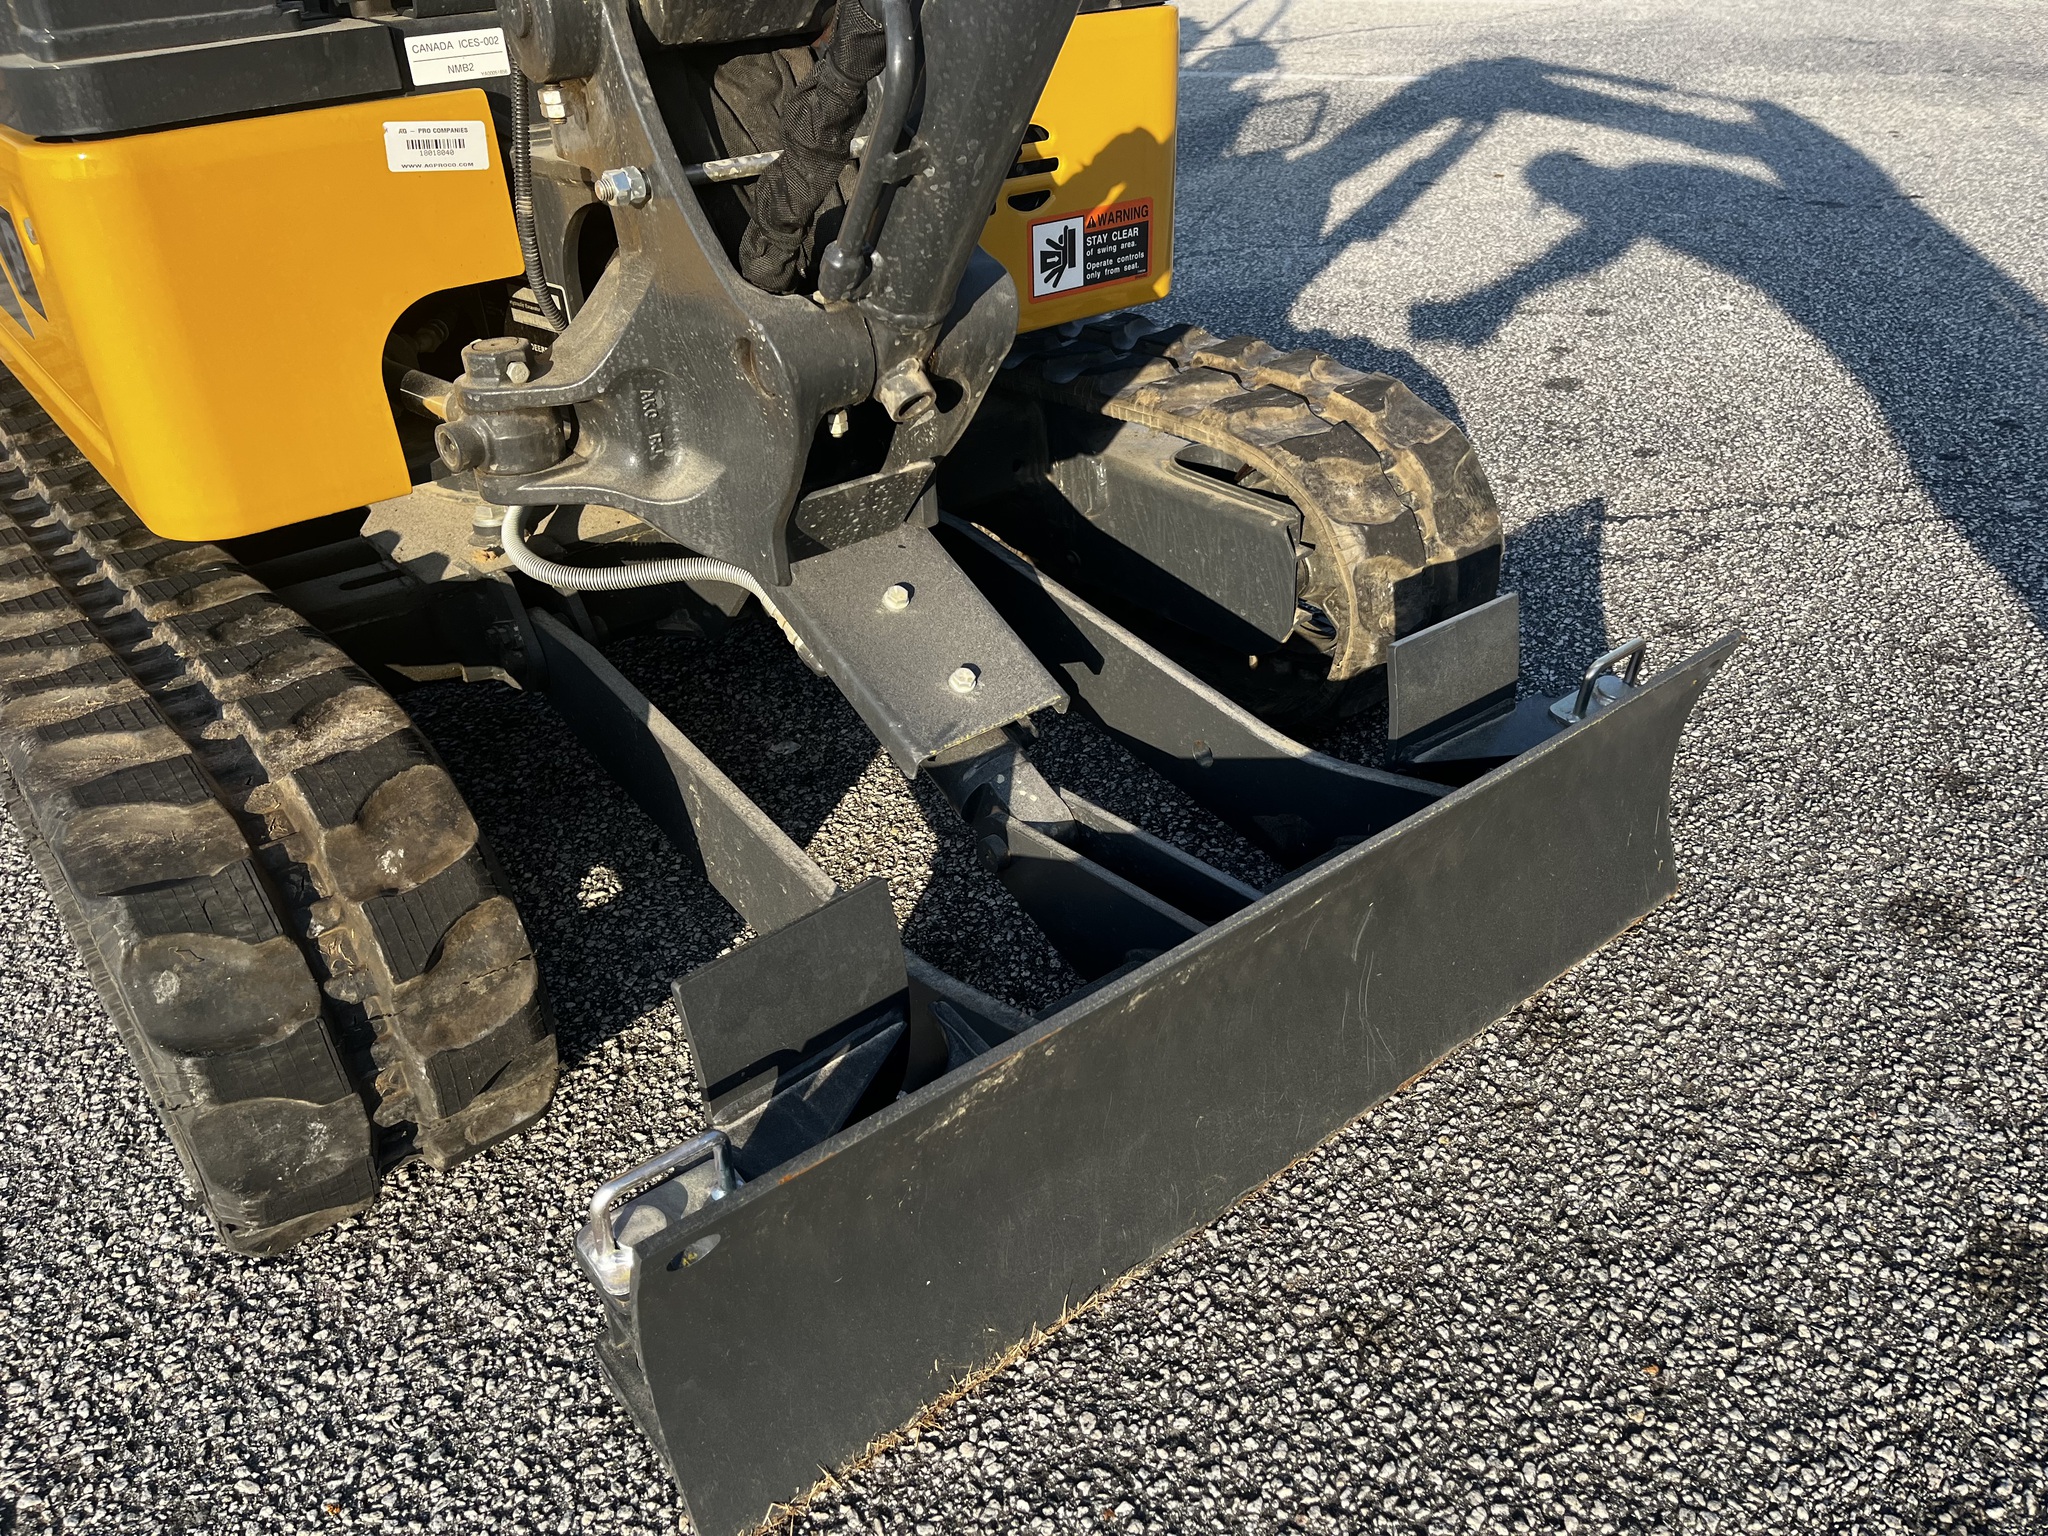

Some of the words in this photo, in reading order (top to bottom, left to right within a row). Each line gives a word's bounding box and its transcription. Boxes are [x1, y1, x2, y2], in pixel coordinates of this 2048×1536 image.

[411, 40, 454, 54] CANADA
[458, 35, 499, 49] ICES-002
[447, 62, 475, 74] NMB2
[1097, 204, 1149, 227] WARNING
[1086, 232, 1108, 247] STAY
[1111, 227, 1139, 241] CLEAR
[1086, 249, 1094, 257] of
[1097, 244, 1117, 255] swing
[1120, 240, 1137, 250] area.
[1086, 258, 1113, 271] Operate
[1117, 251, 1145, 264] controls
[1086, 268, 1101, 280] only
[1104, 266, 1121, 276] from
[1124, 262, 1139, 272] seat.
